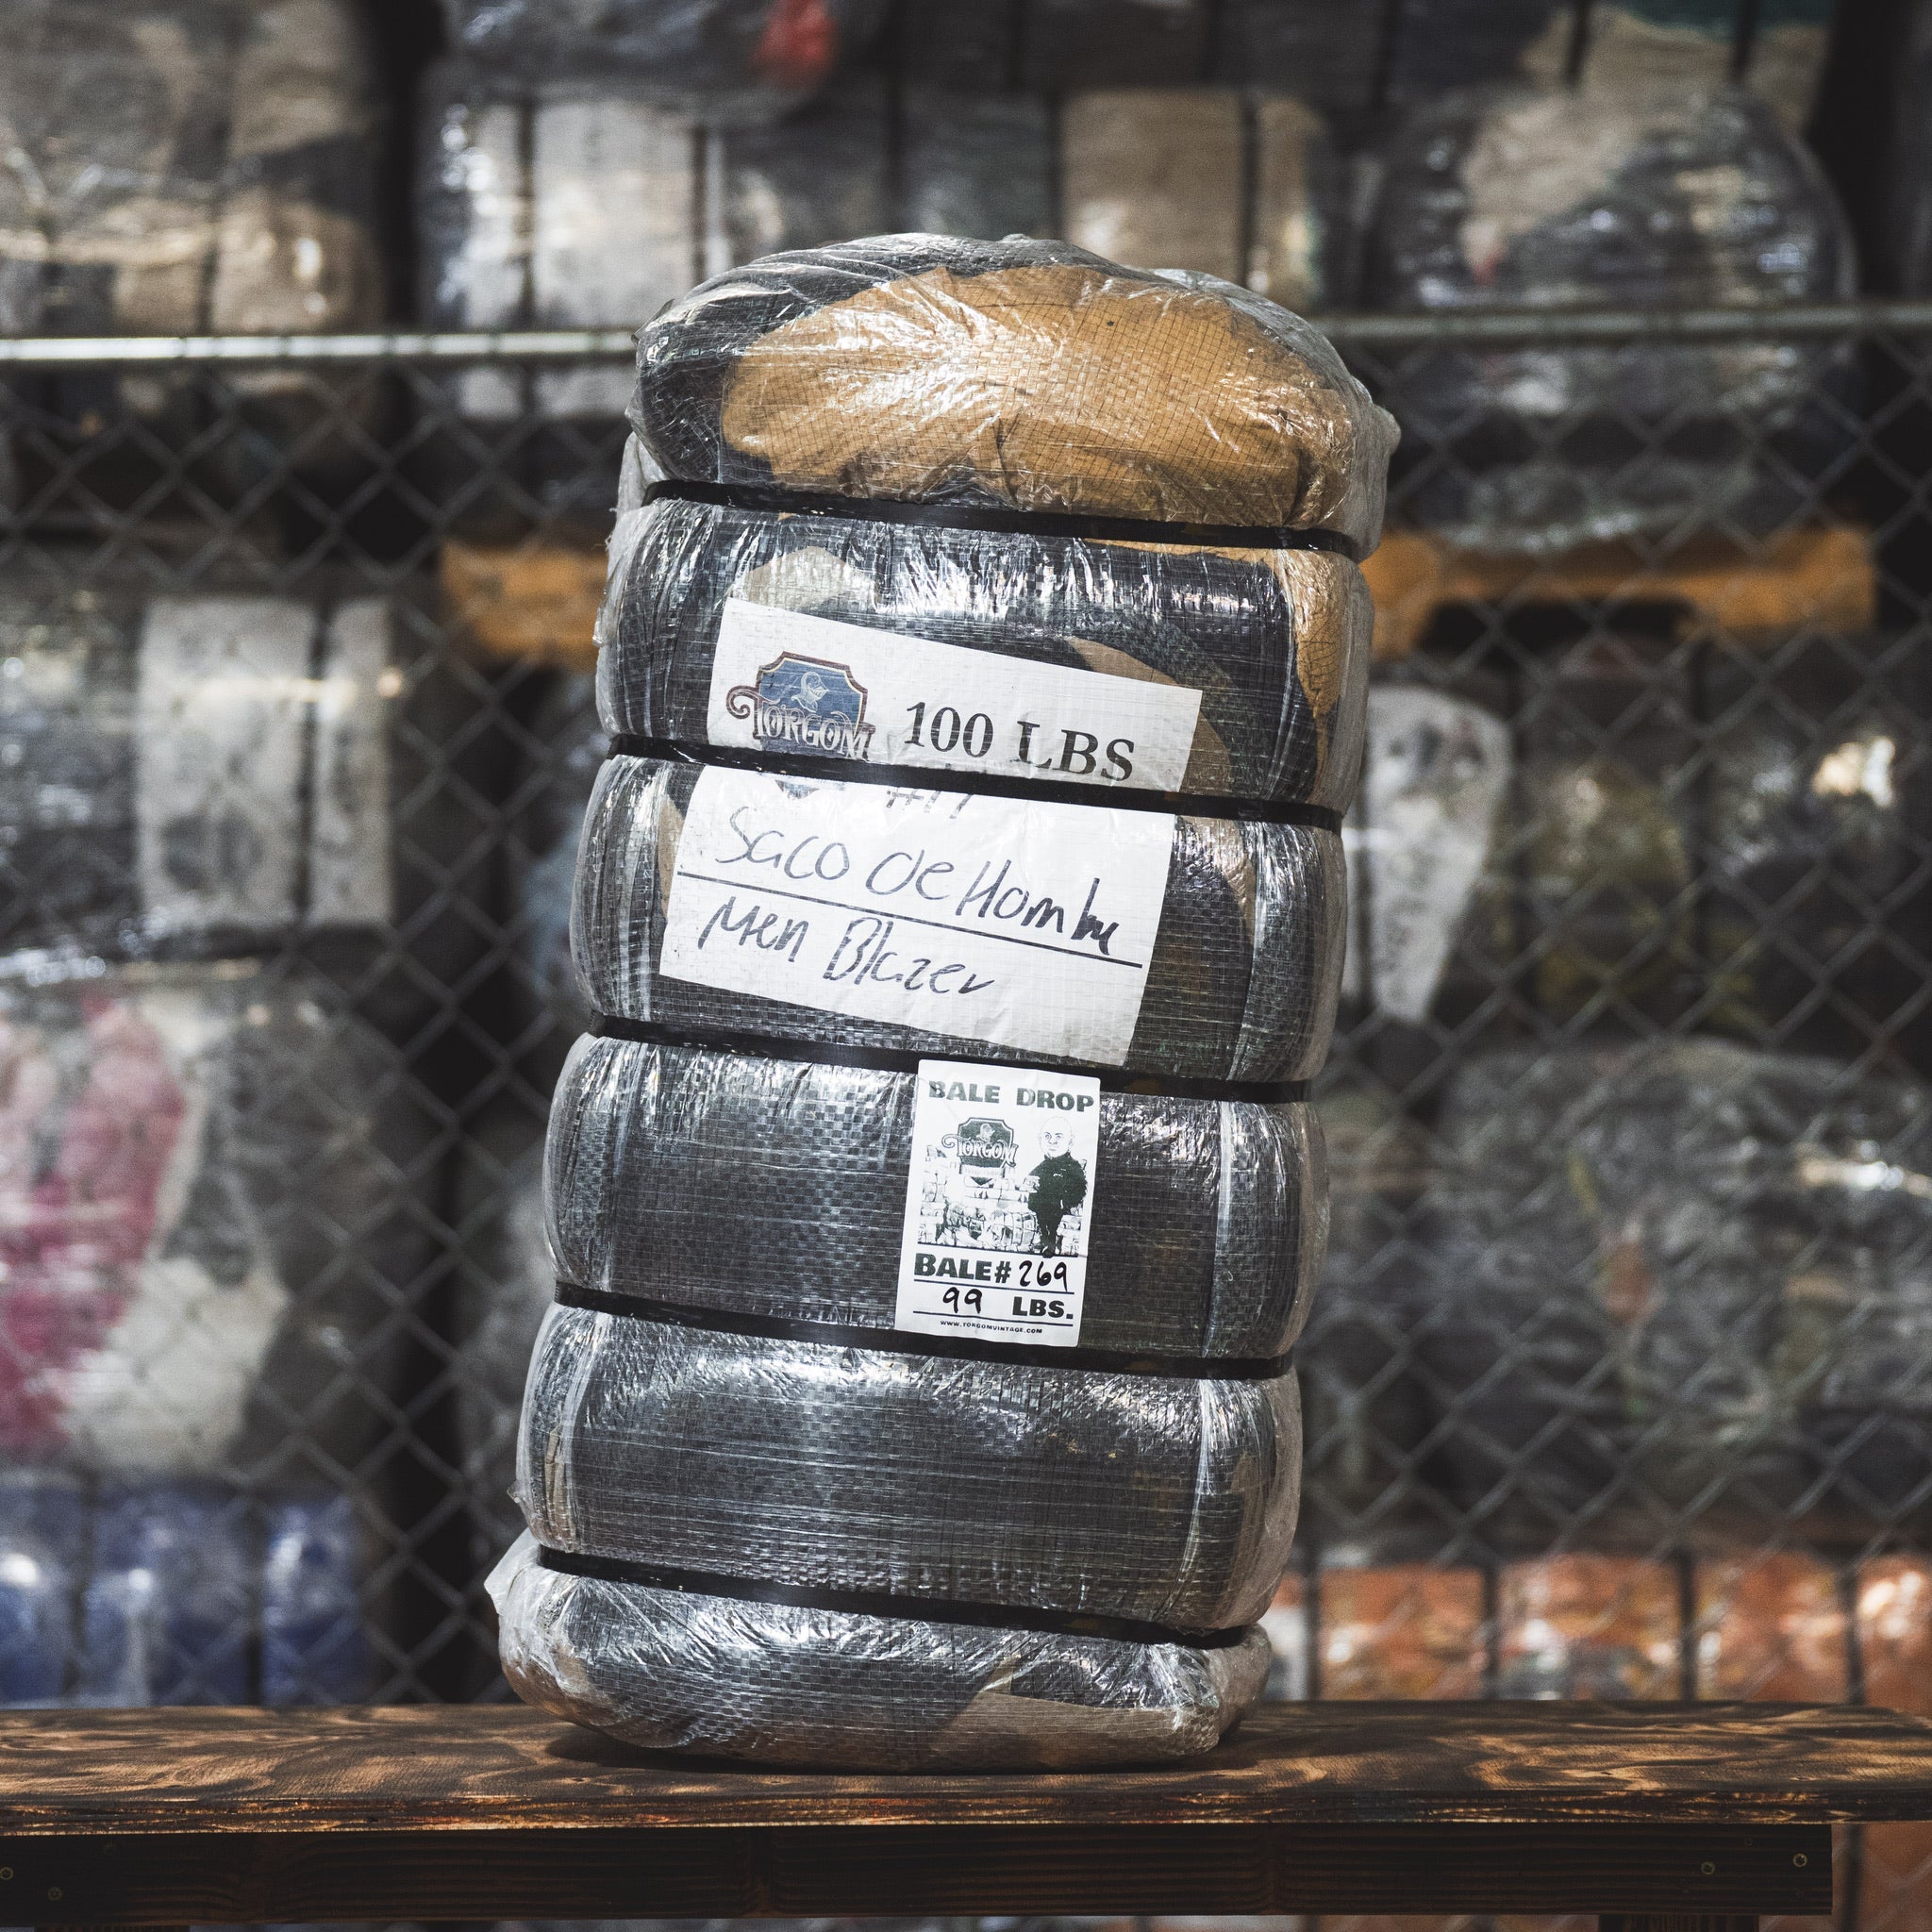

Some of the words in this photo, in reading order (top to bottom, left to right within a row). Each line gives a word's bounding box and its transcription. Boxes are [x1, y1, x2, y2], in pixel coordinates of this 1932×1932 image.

[726, 686, 875, 762] TORGOM
[905, 702, 994, 758] 100
[1011, 720, 1135, 782] LBS
[715, 806, 851, 881] Saco
[697, 895, 809, 964] Men
[823, 915, 996, 995] Blazer
[928, 1080, 1000, 1104] BALE
[1016, 1087, 1094, 1112] DROP
[941, 1134, 1019, 1167] TORGOM
[913, 1252, 1012, 1284] BALE#
[1018, 1259, 1068, 1291] 269
[942, 1286, 984, 1314] 99
[1012, 1296, 1074, 1320] LBS.
